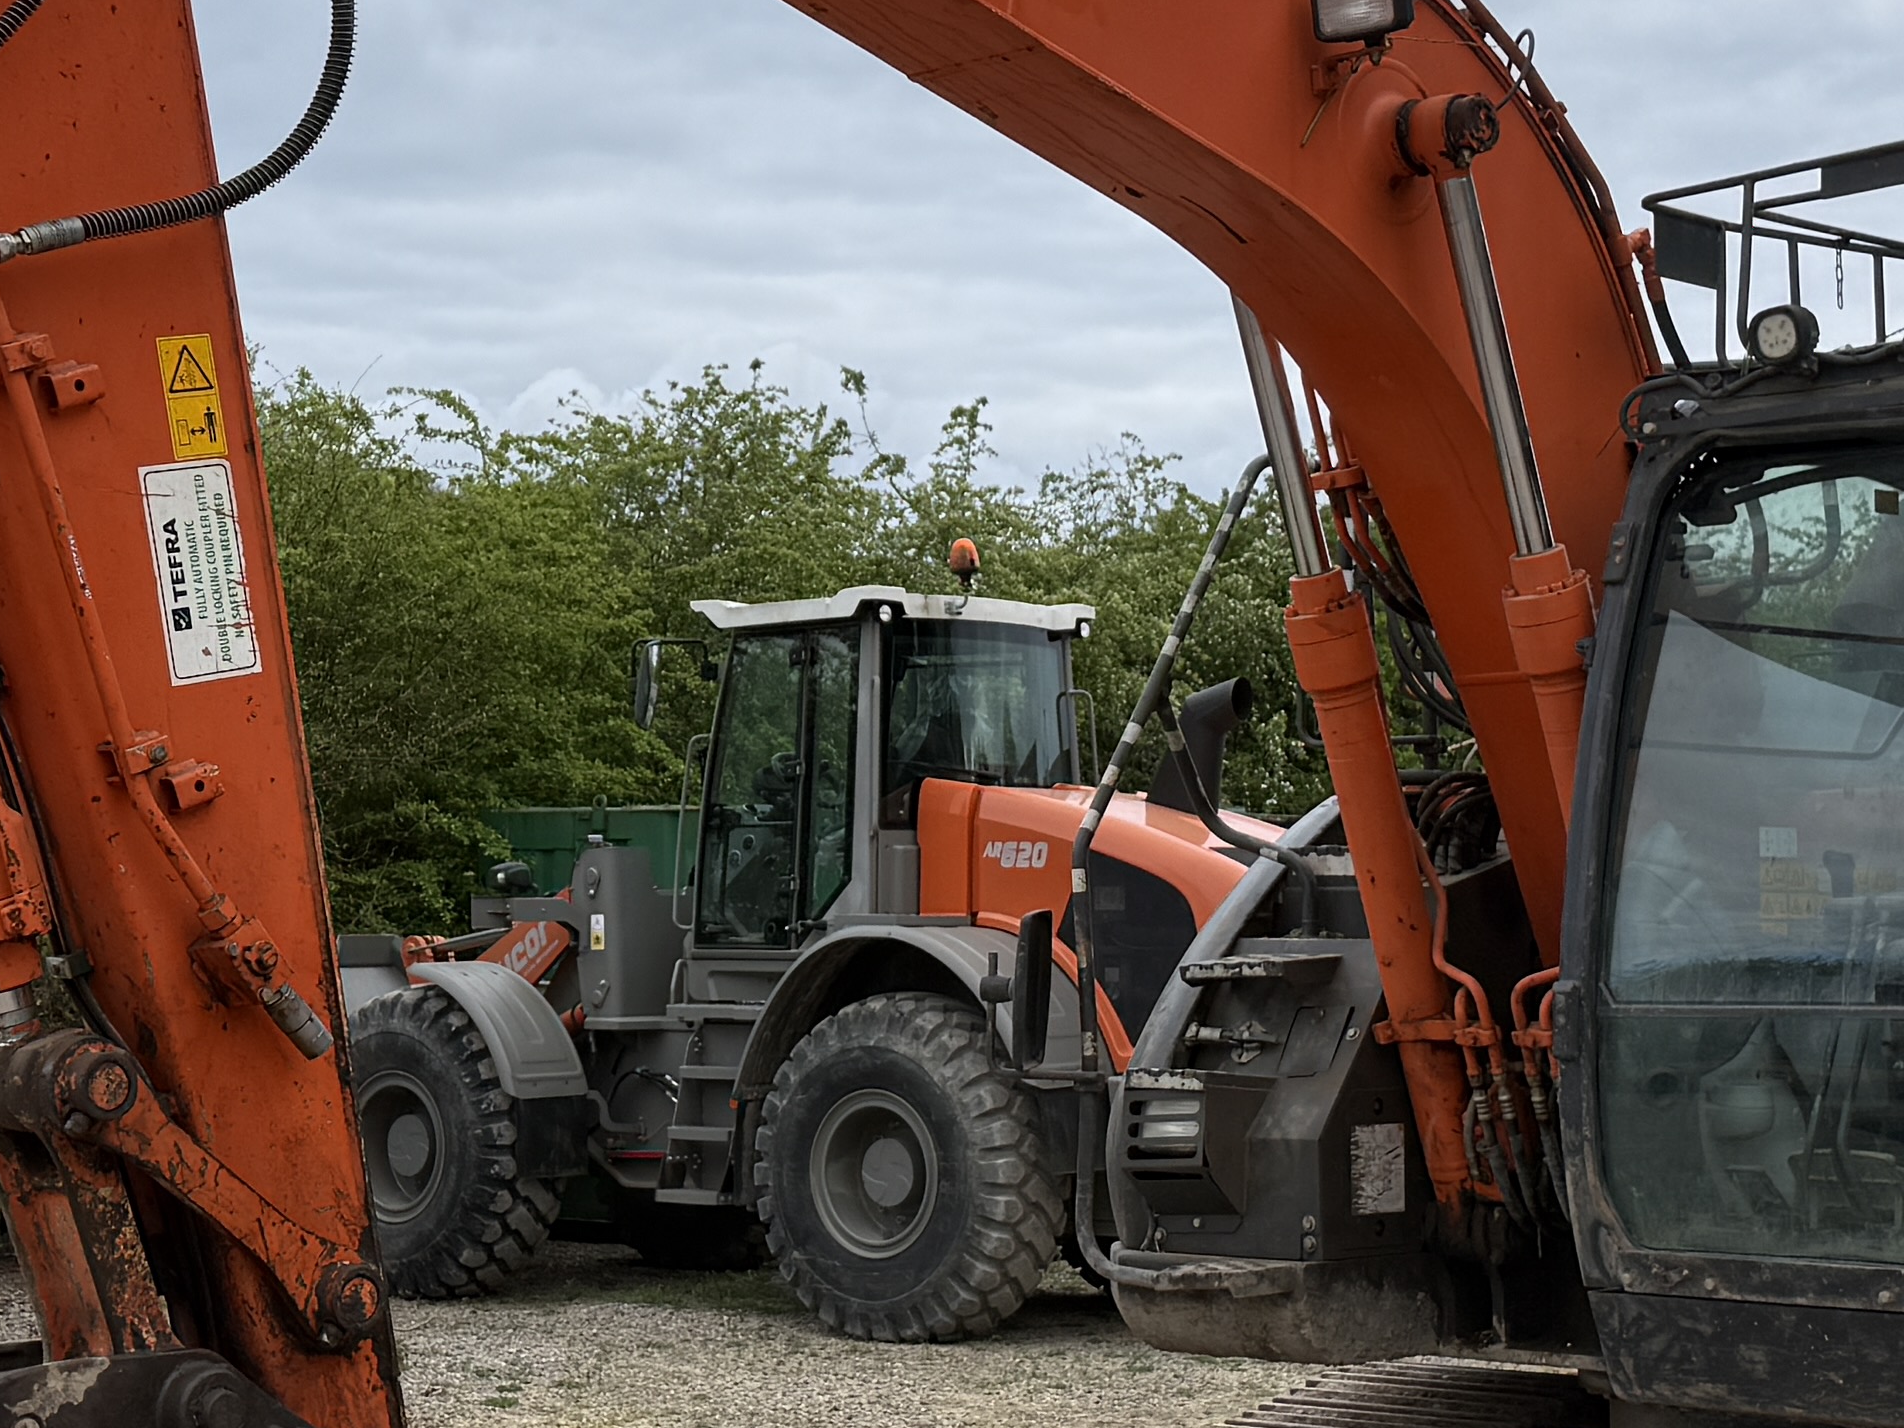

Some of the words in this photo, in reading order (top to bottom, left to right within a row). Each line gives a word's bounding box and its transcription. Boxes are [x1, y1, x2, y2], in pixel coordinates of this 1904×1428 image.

[194, 474, 207, 511] FITTED
[163, 518, 188, 603] TEFRA
[184, 520, 203, 584] AUTOMATIC
[200, 515, 216, 564] COUPLER
[194, 588, 208, 619] FULLY
[208, 567, 224, 614] LOCKING
[226, 578, 241, 619] SAFETY
[233, 621, 244, 637] N
